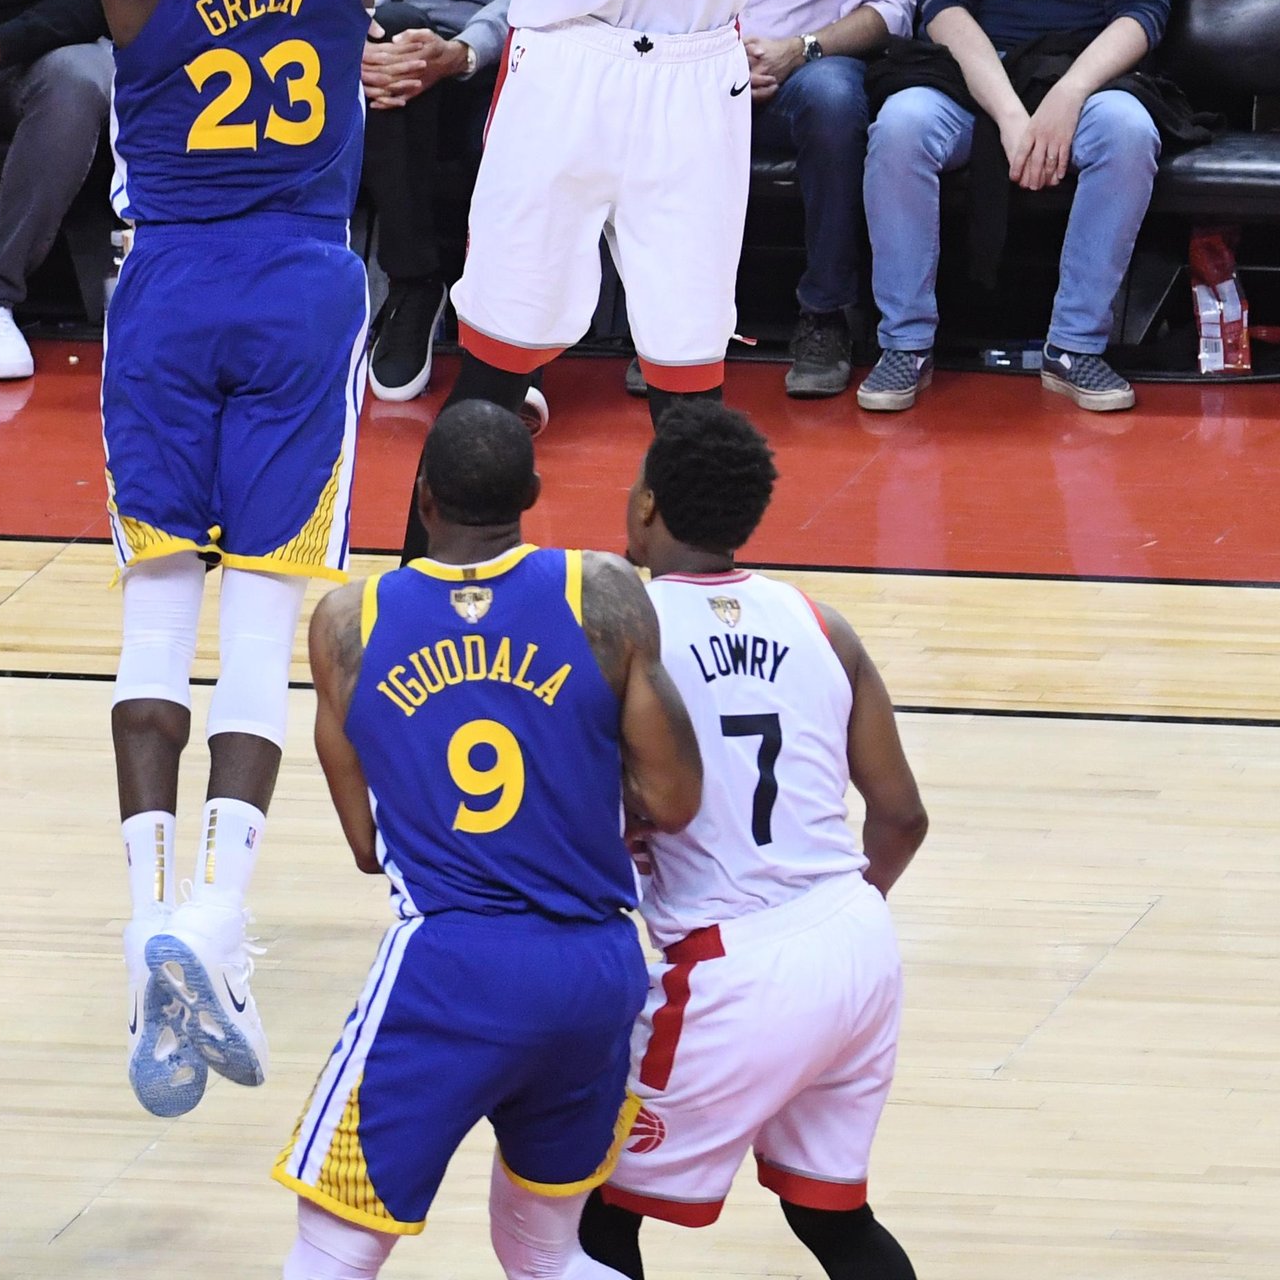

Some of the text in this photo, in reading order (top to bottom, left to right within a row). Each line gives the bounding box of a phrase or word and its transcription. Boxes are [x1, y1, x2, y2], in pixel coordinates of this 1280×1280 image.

[183, 38, 326, 154] 23
[376, 634, 573, 718] IGUODALA
[689, 632, 790, 684] LOWRY
[446, 719, 525, 834] 9
[720, 712, 783, 847] 7
